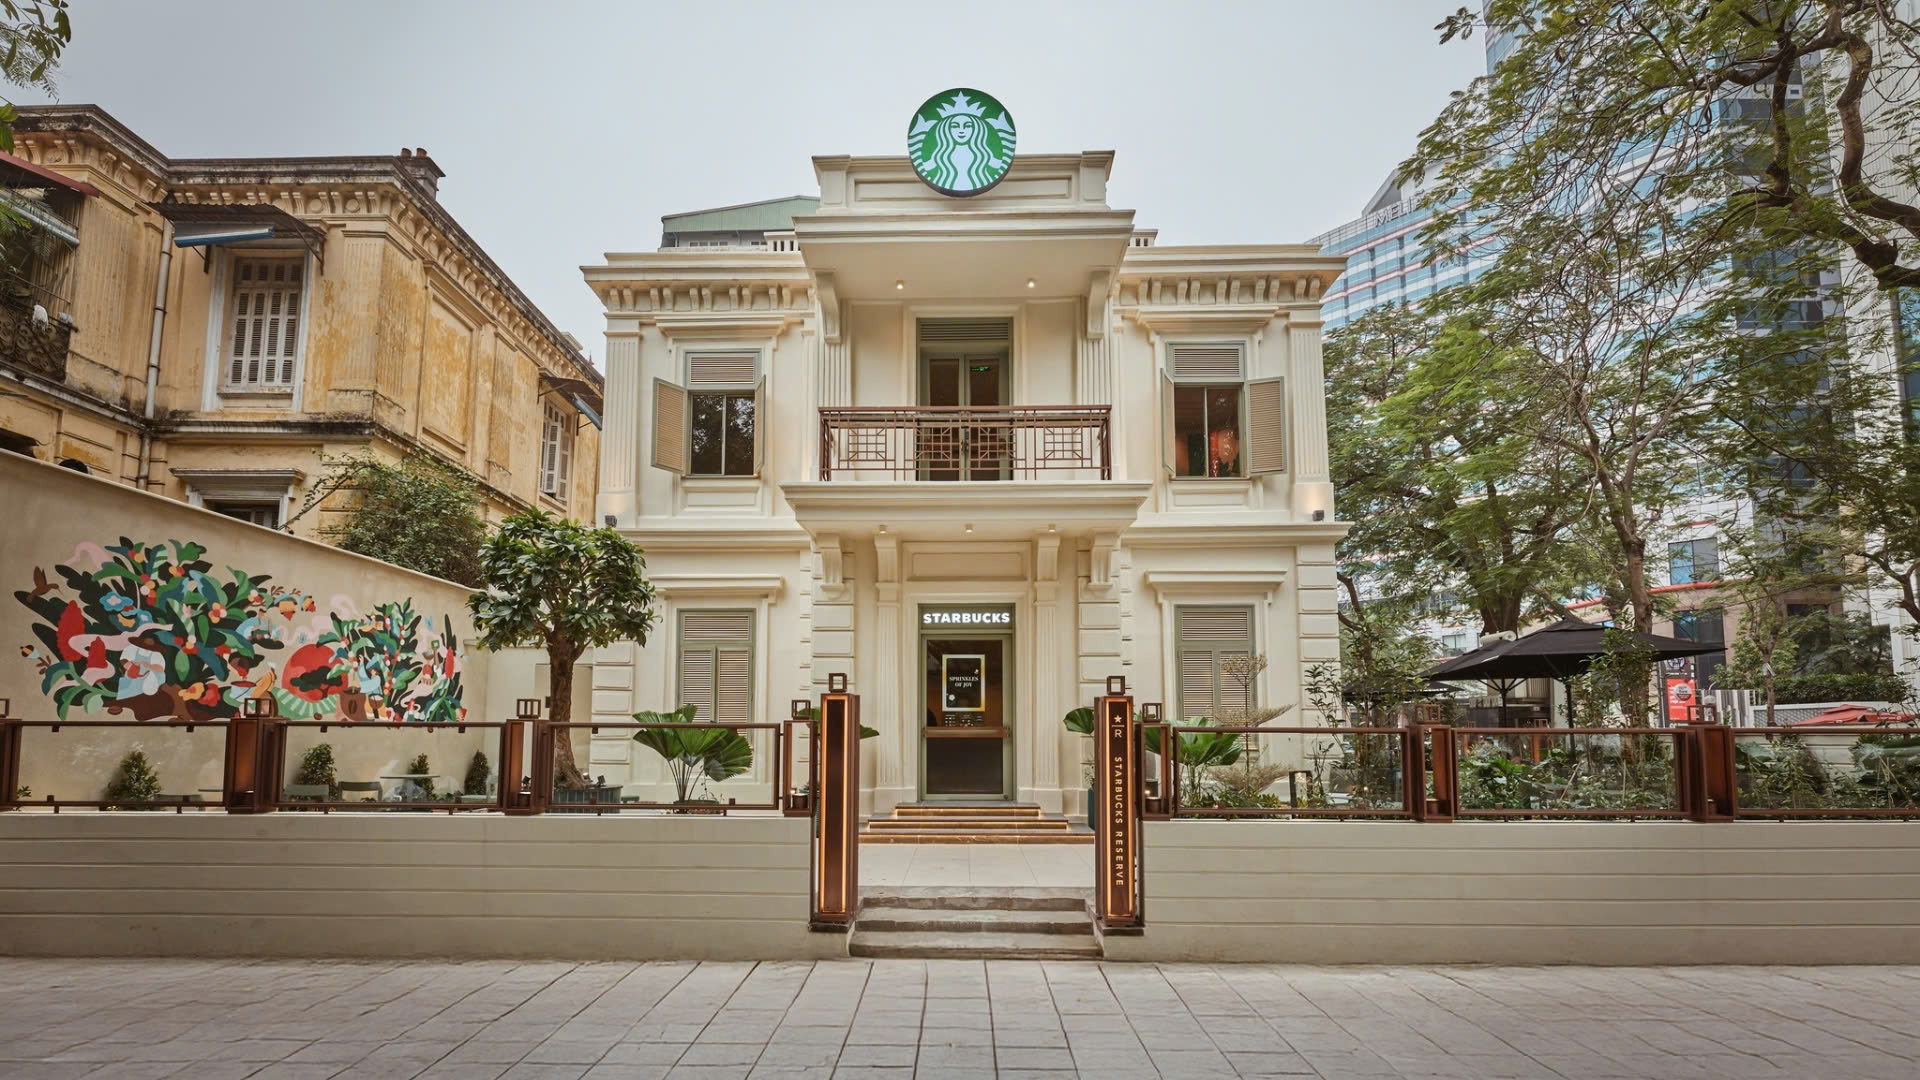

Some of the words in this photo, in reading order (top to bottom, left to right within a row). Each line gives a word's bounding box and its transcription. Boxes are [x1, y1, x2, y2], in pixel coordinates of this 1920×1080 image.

[923, 612, 1010, 624] STARBUCKS
[1114, 728, 1122, 738] R
[1114, 756, 1123, 824] STARBUCKS
[1115, 830, 1124, 886] RESERVE
